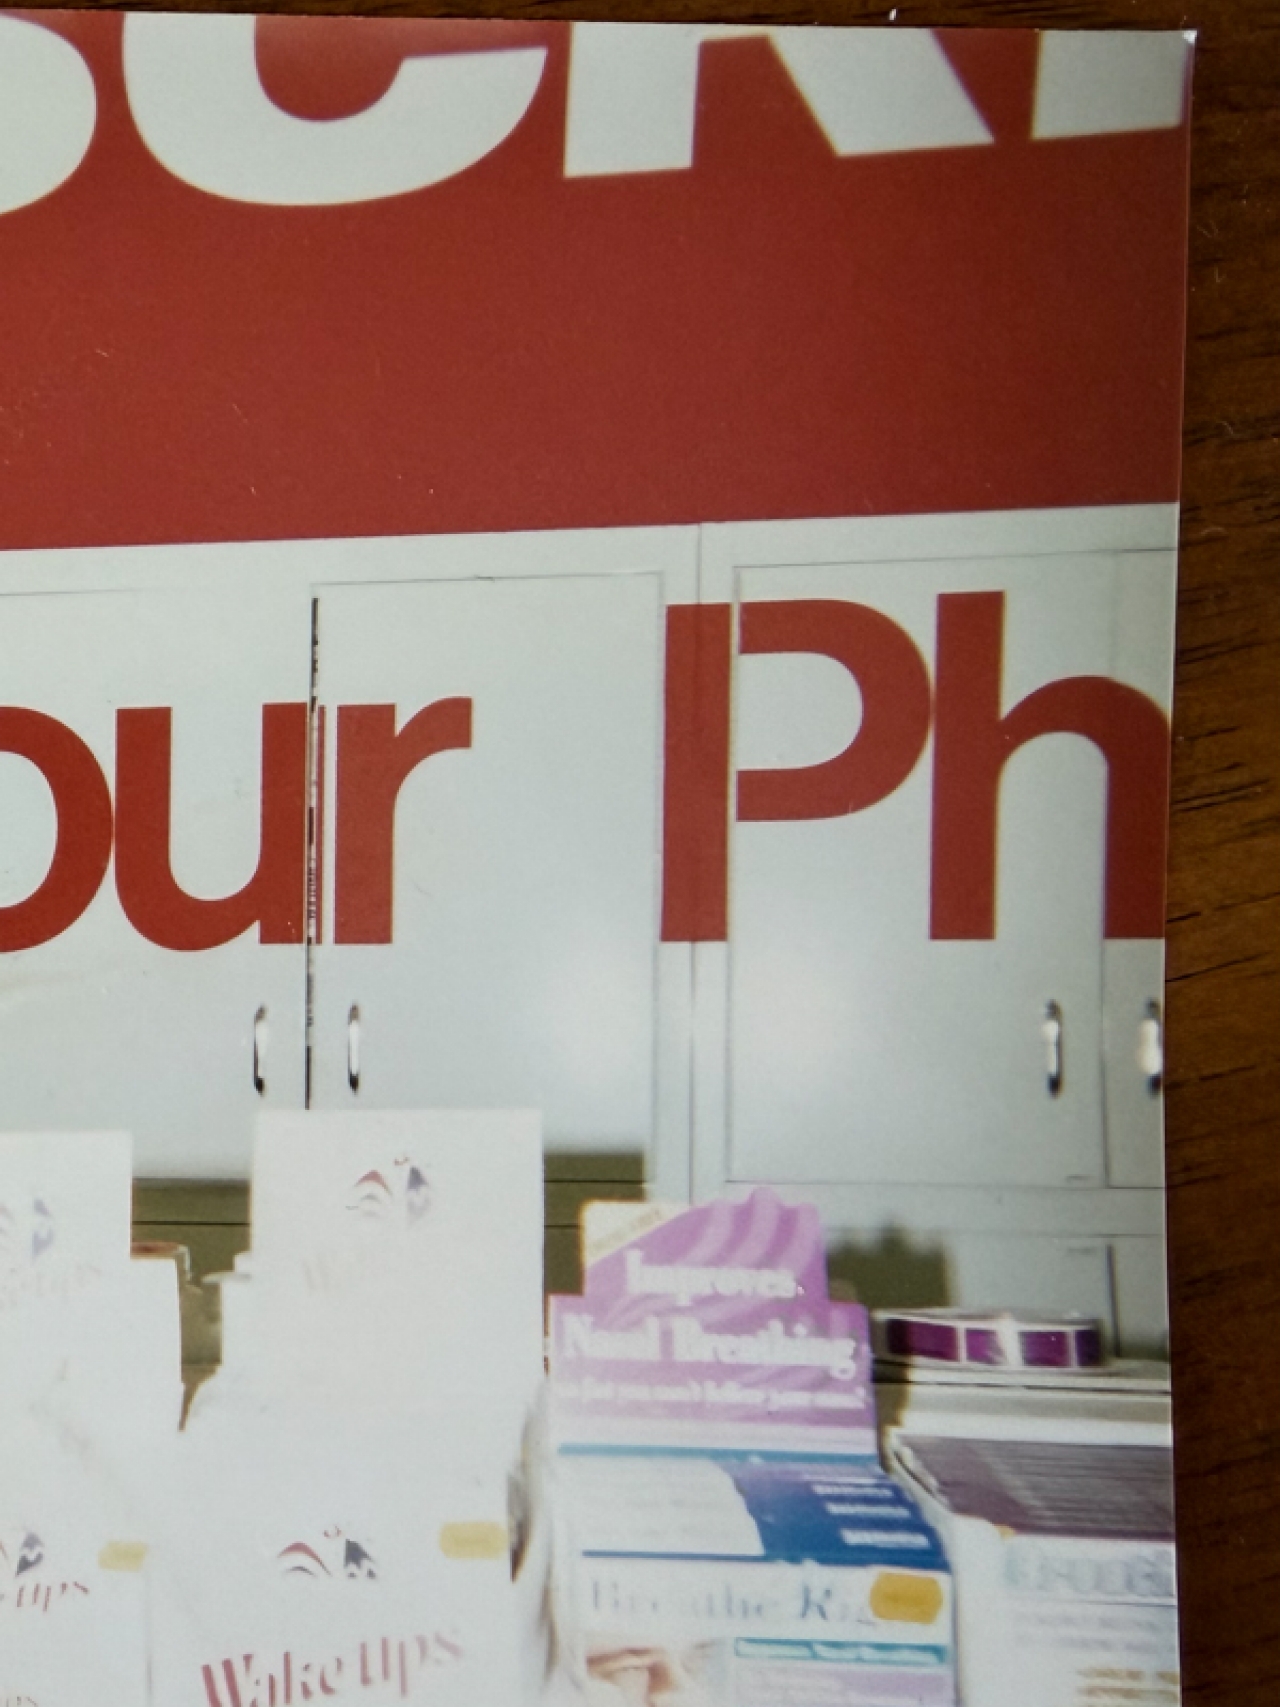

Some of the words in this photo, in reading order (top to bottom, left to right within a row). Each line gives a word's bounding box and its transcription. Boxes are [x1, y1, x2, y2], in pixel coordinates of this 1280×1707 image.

[660, 591, 1171, 942] Ph
[199, 1649, 347, 1707] Wake
[357, 1626, 465, 1700] Ups
